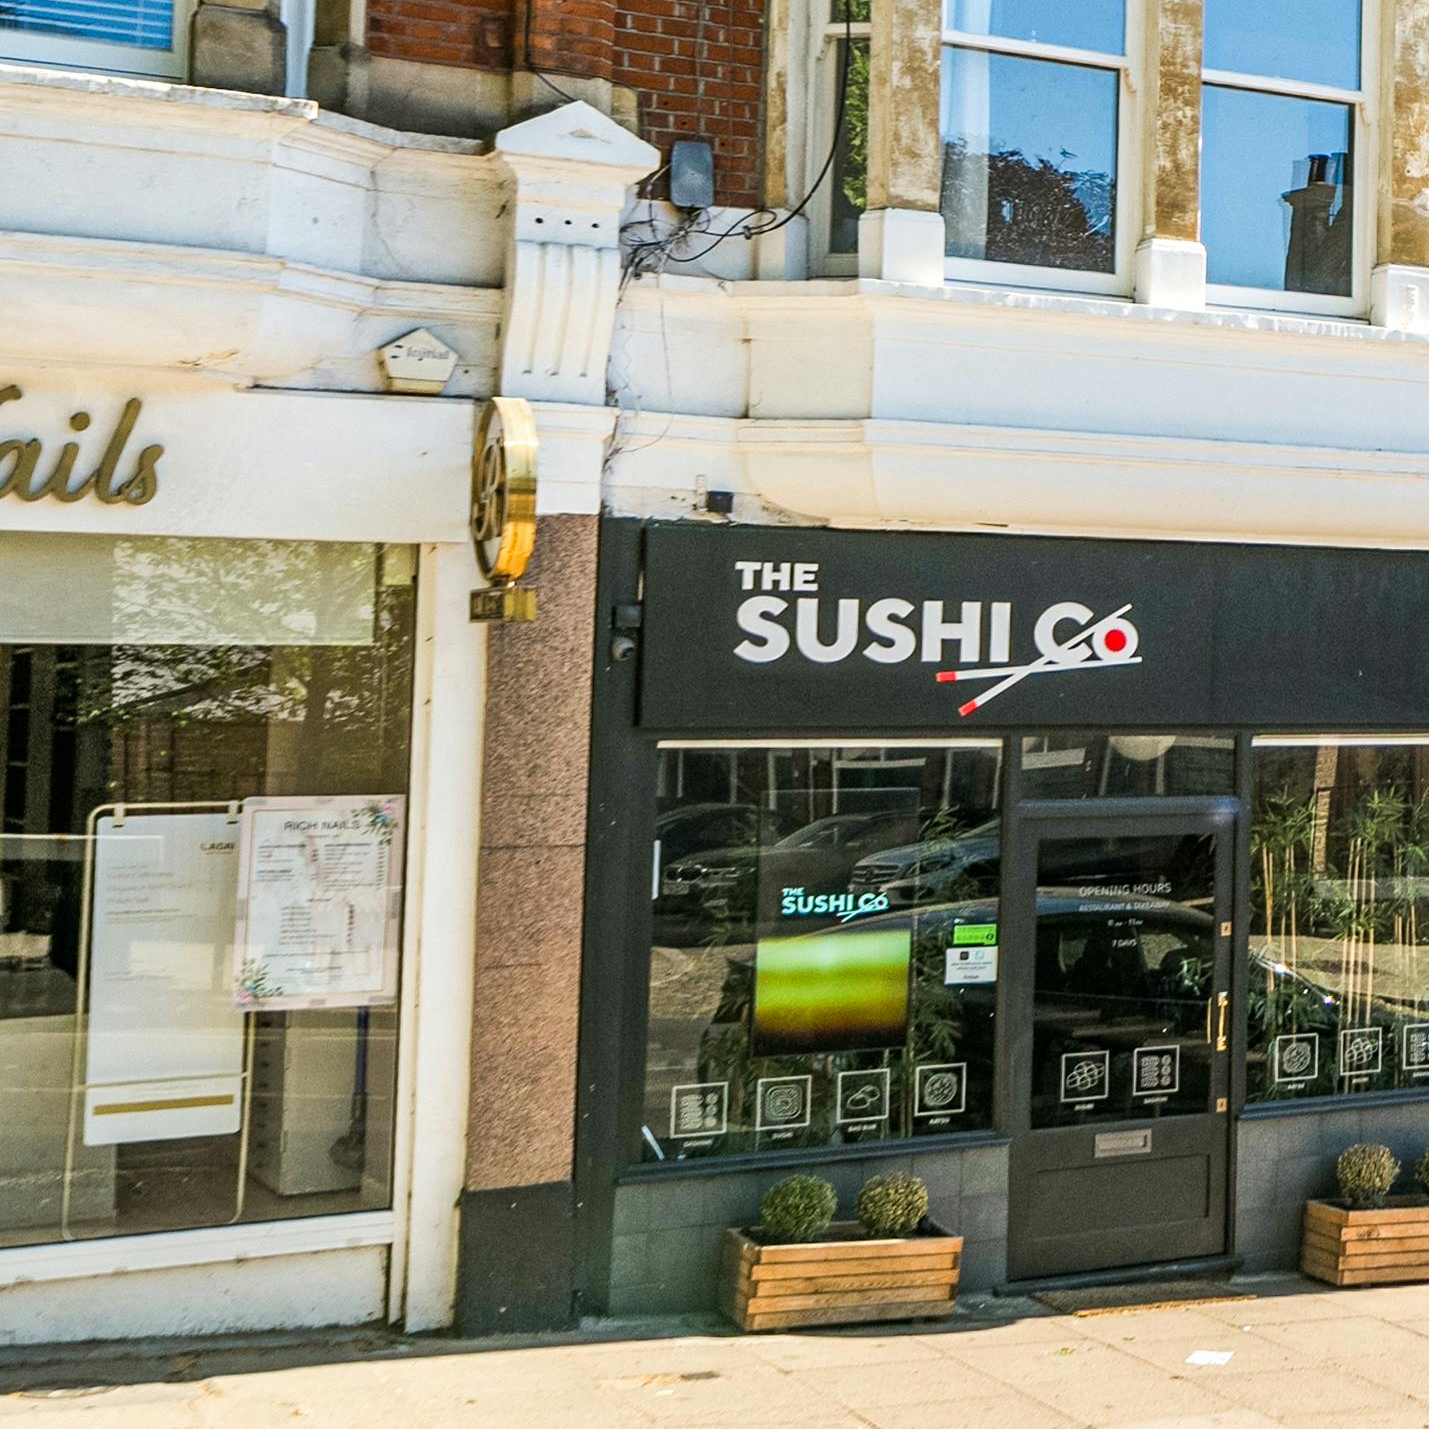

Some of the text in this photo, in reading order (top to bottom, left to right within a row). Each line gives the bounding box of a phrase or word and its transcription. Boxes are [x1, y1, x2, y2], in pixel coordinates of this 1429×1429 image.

[0, 384, 165, 505] ails
[735, 561, 819, 592] THE
[733, 595, 1012, 664] SUSHI
[782, 887, 805, 897] THE
[1079, 882, 1172, 898] OPENING HOURS
[781, 893, 855, 916] SUSHI
